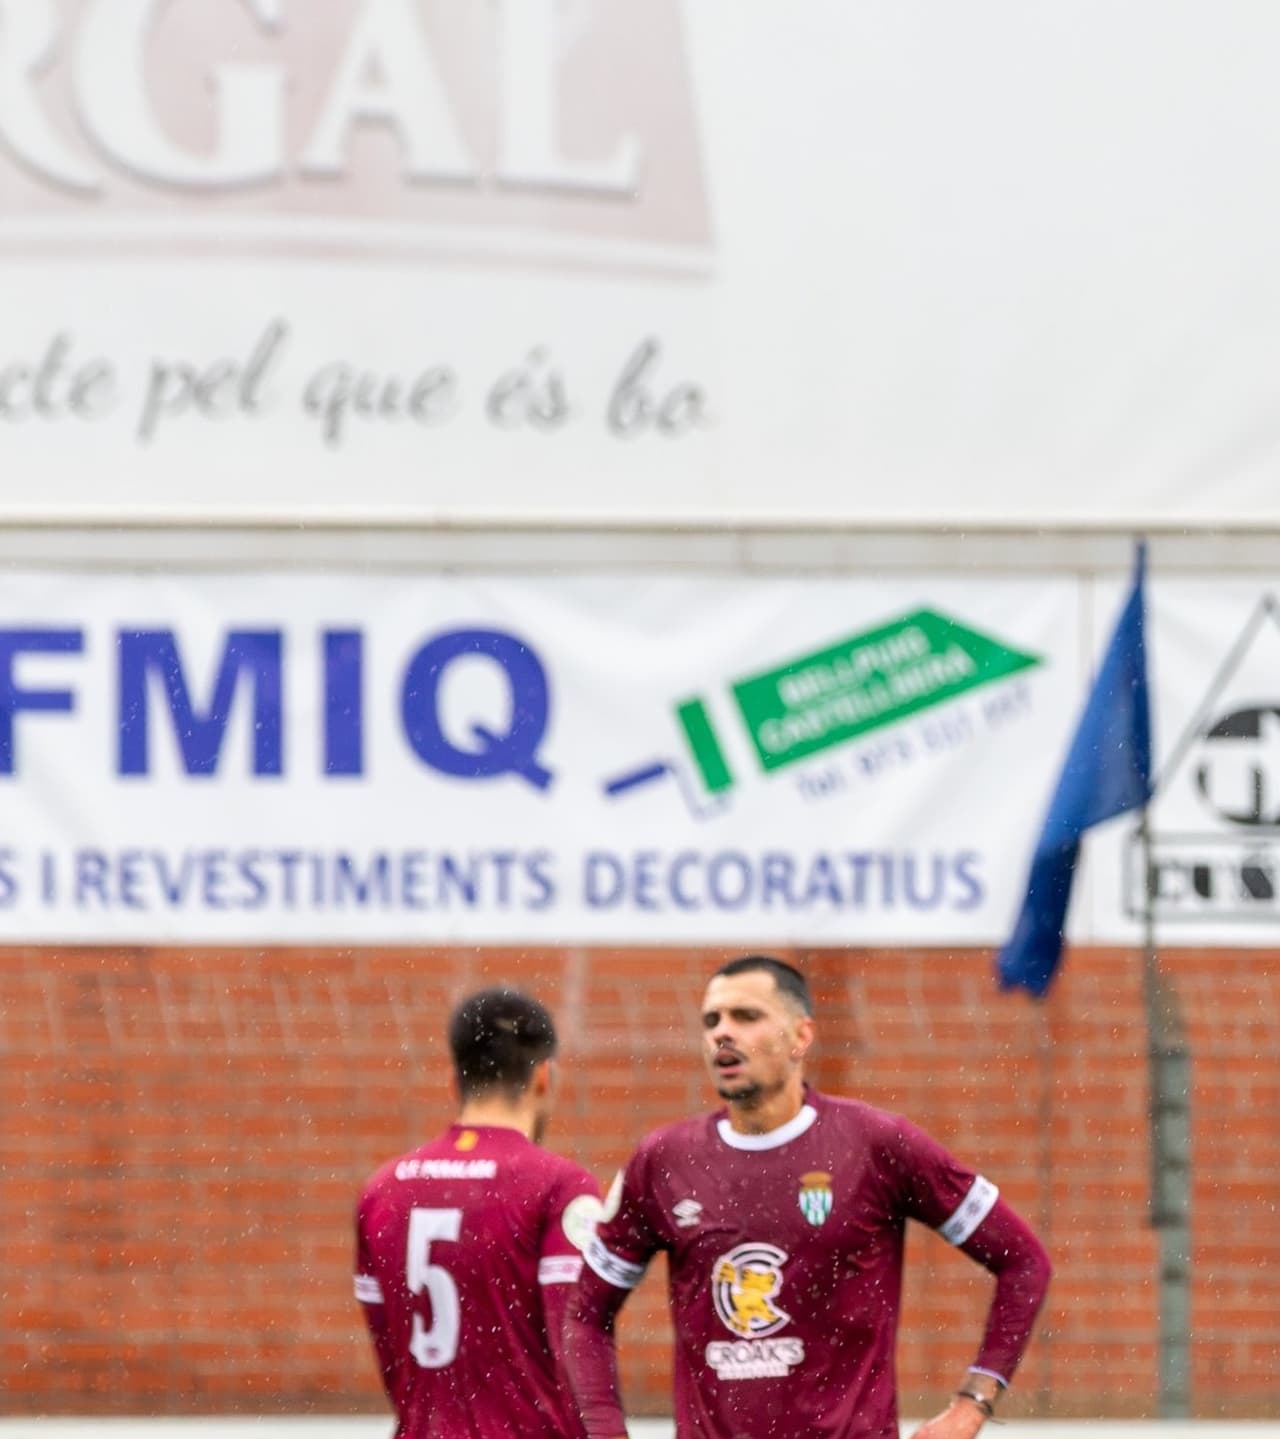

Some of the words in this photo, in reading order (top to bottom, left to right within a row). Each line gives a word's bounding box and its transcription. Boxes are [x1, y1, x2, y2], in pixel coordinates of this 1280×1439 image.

[135, 318, 290, 446] pel
[302, 362, 460, 450] que
[604, 335, 712, 440] bo
[0, 625, 555, 792] FMIQ
[76, 849, 554, 913] REVESTIMENTS
[583, 849, 985, 913] DECORATIUS
[407, 1206, 464, 1370] 5
